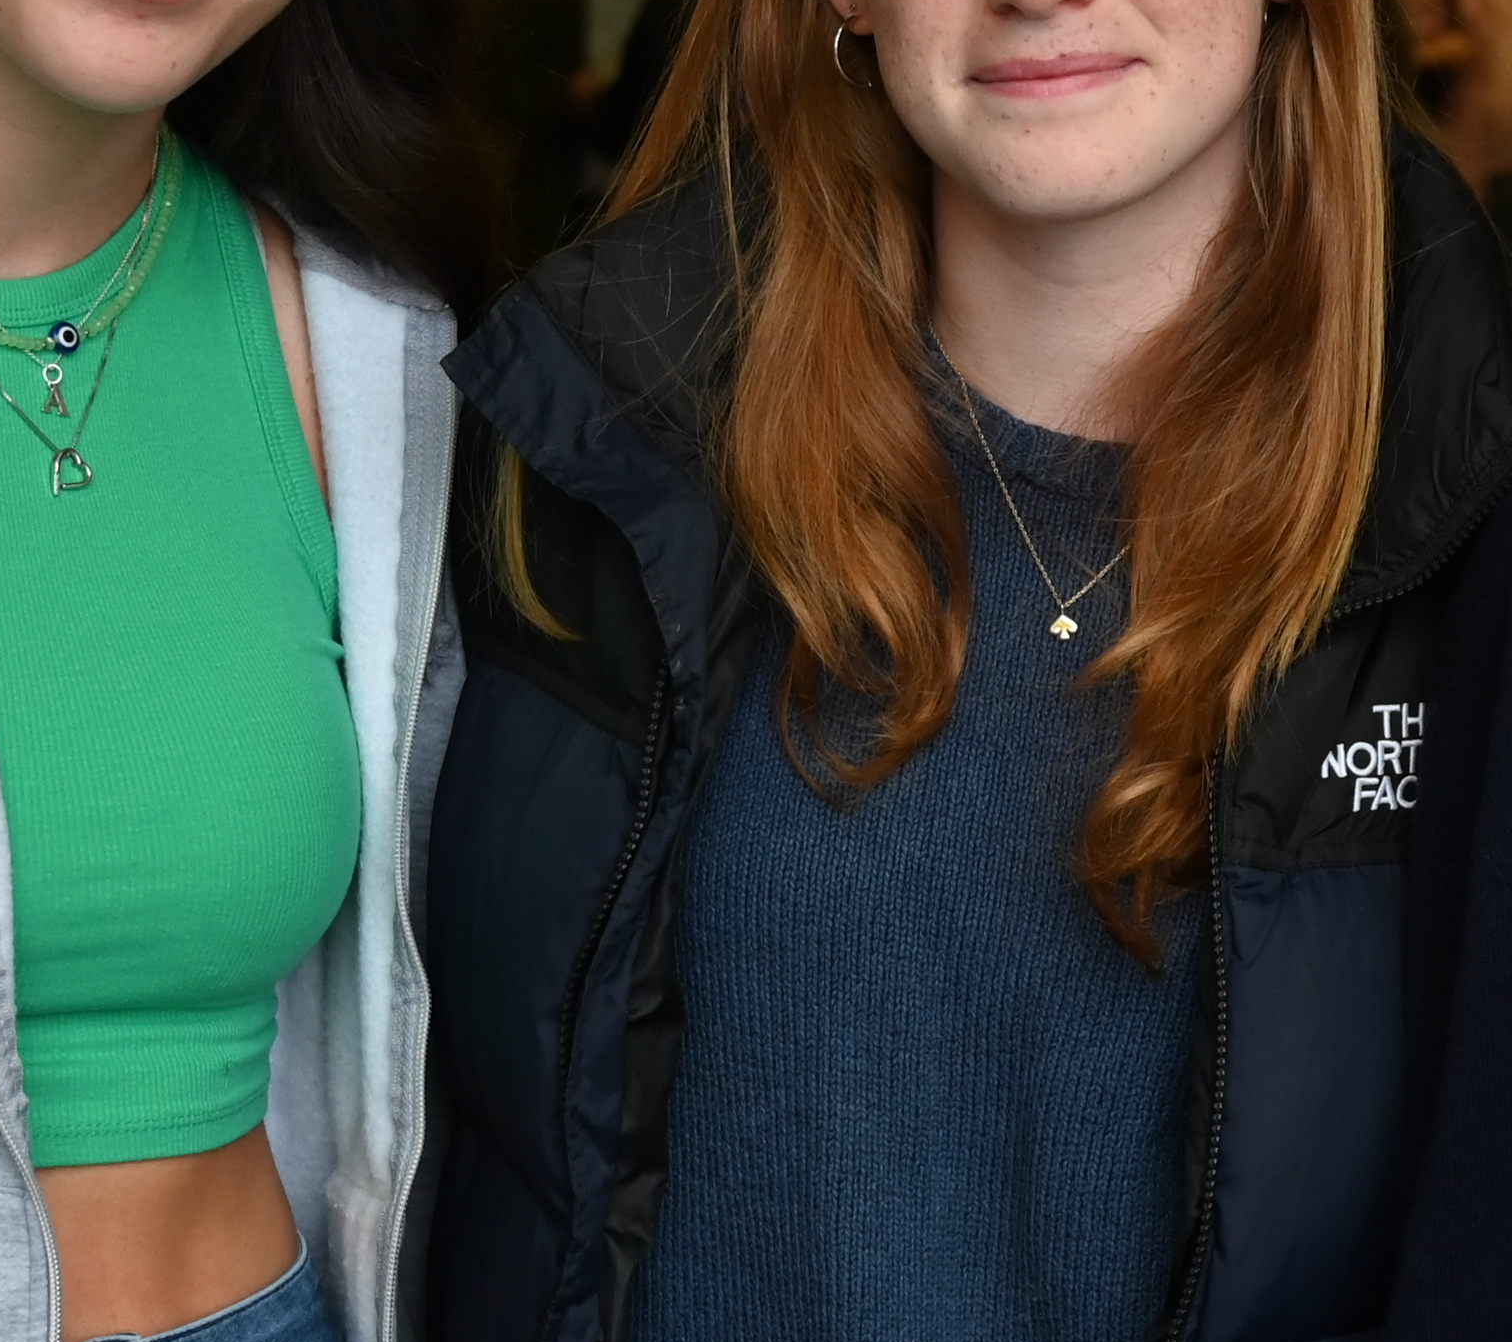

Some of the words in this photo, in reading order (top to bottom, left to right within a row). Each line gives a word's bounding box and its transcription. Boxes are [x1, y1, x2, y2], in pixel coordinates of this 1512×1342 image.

[1372, 701, 1425, 738] TH
[1320, 738, 1424, 779] NORT
[1352, 775, 1418, 812] FAC
